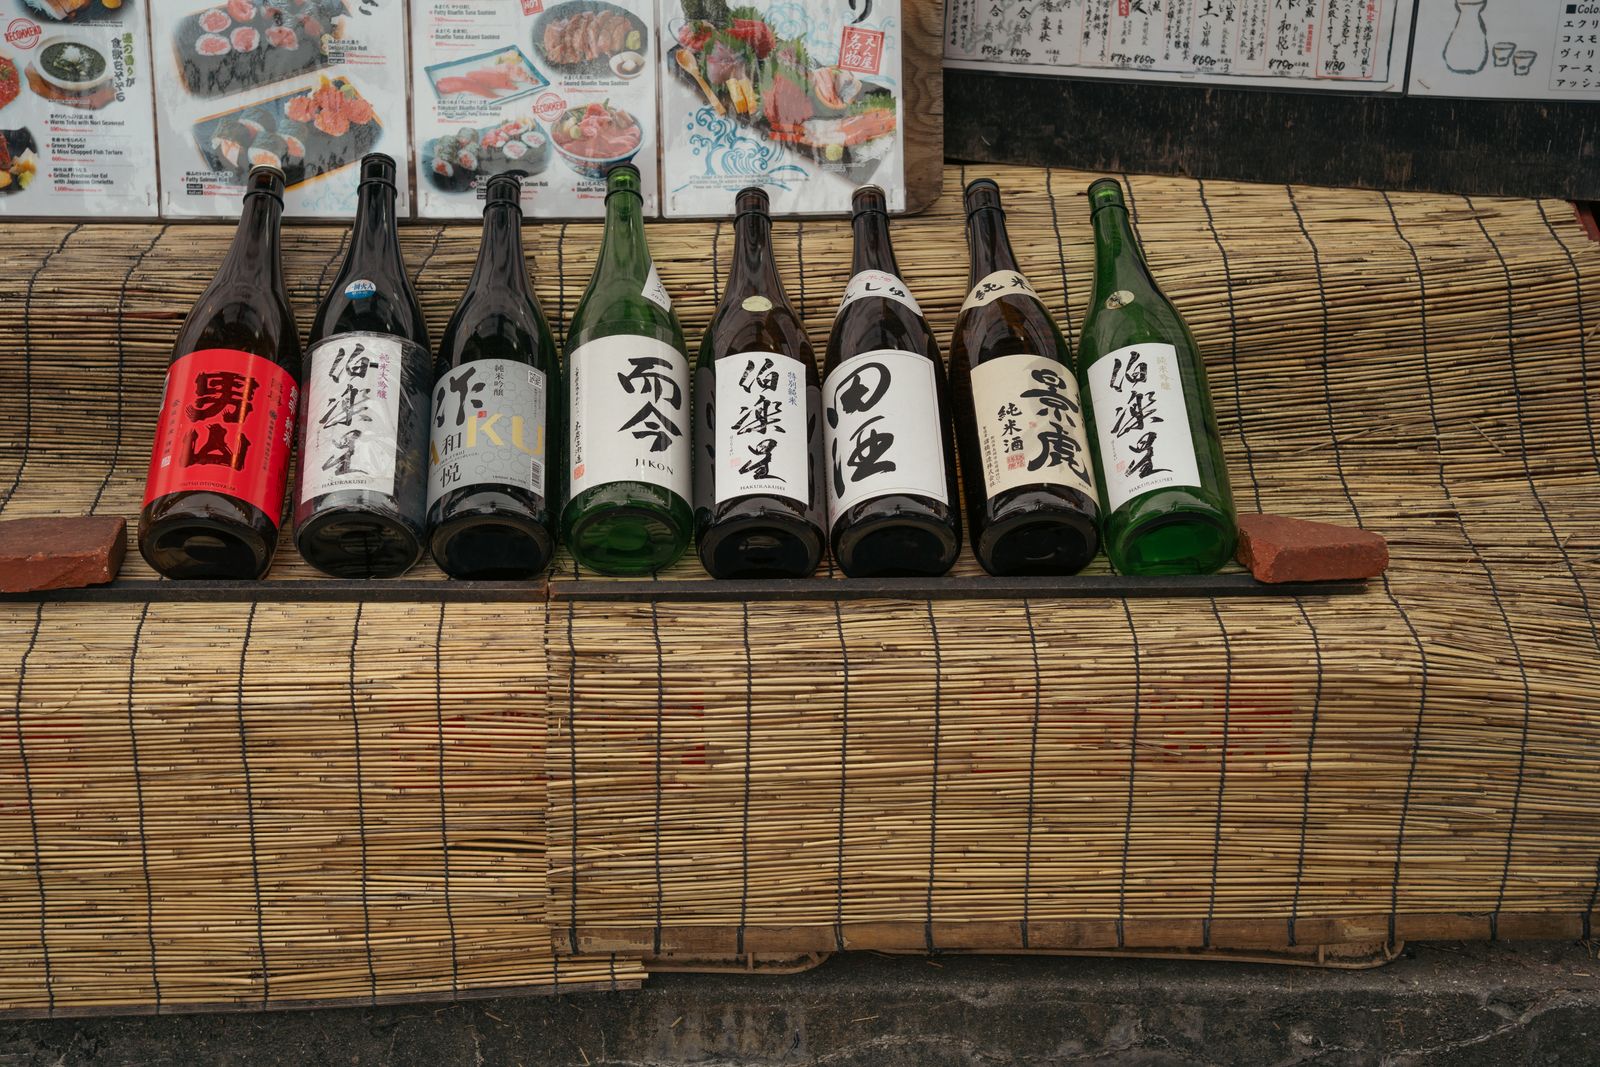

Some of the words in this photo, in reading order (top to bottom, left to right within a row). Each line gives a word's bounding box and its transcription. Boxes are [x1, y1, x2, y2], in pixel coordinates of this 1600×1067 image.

[1563, 20, 1599, 29] エクリ
[4, 25, 42, 43] RECOMMEND
[1563, 35, 1597, 43] コスモ
[1560, 48, 1594, 59] ヴィリ
[1558, 65, 1593, 73] アース
[532, 100, 567, 115] RECOMMEND
[319, 343, 373, 476] 伯楽星
[617, 356, 682, 452] 而今
[182, 371, 260, 472] 男山
[731, 358, 787, 483] 伯楽星
[1109, 351, 1173, 479] 伯楽星
[998, 402, 1025, 453] 純米酒
[635, 457, 674, 476] JIKON
[321, 479, 367, 489] HAKURAKUSEI
